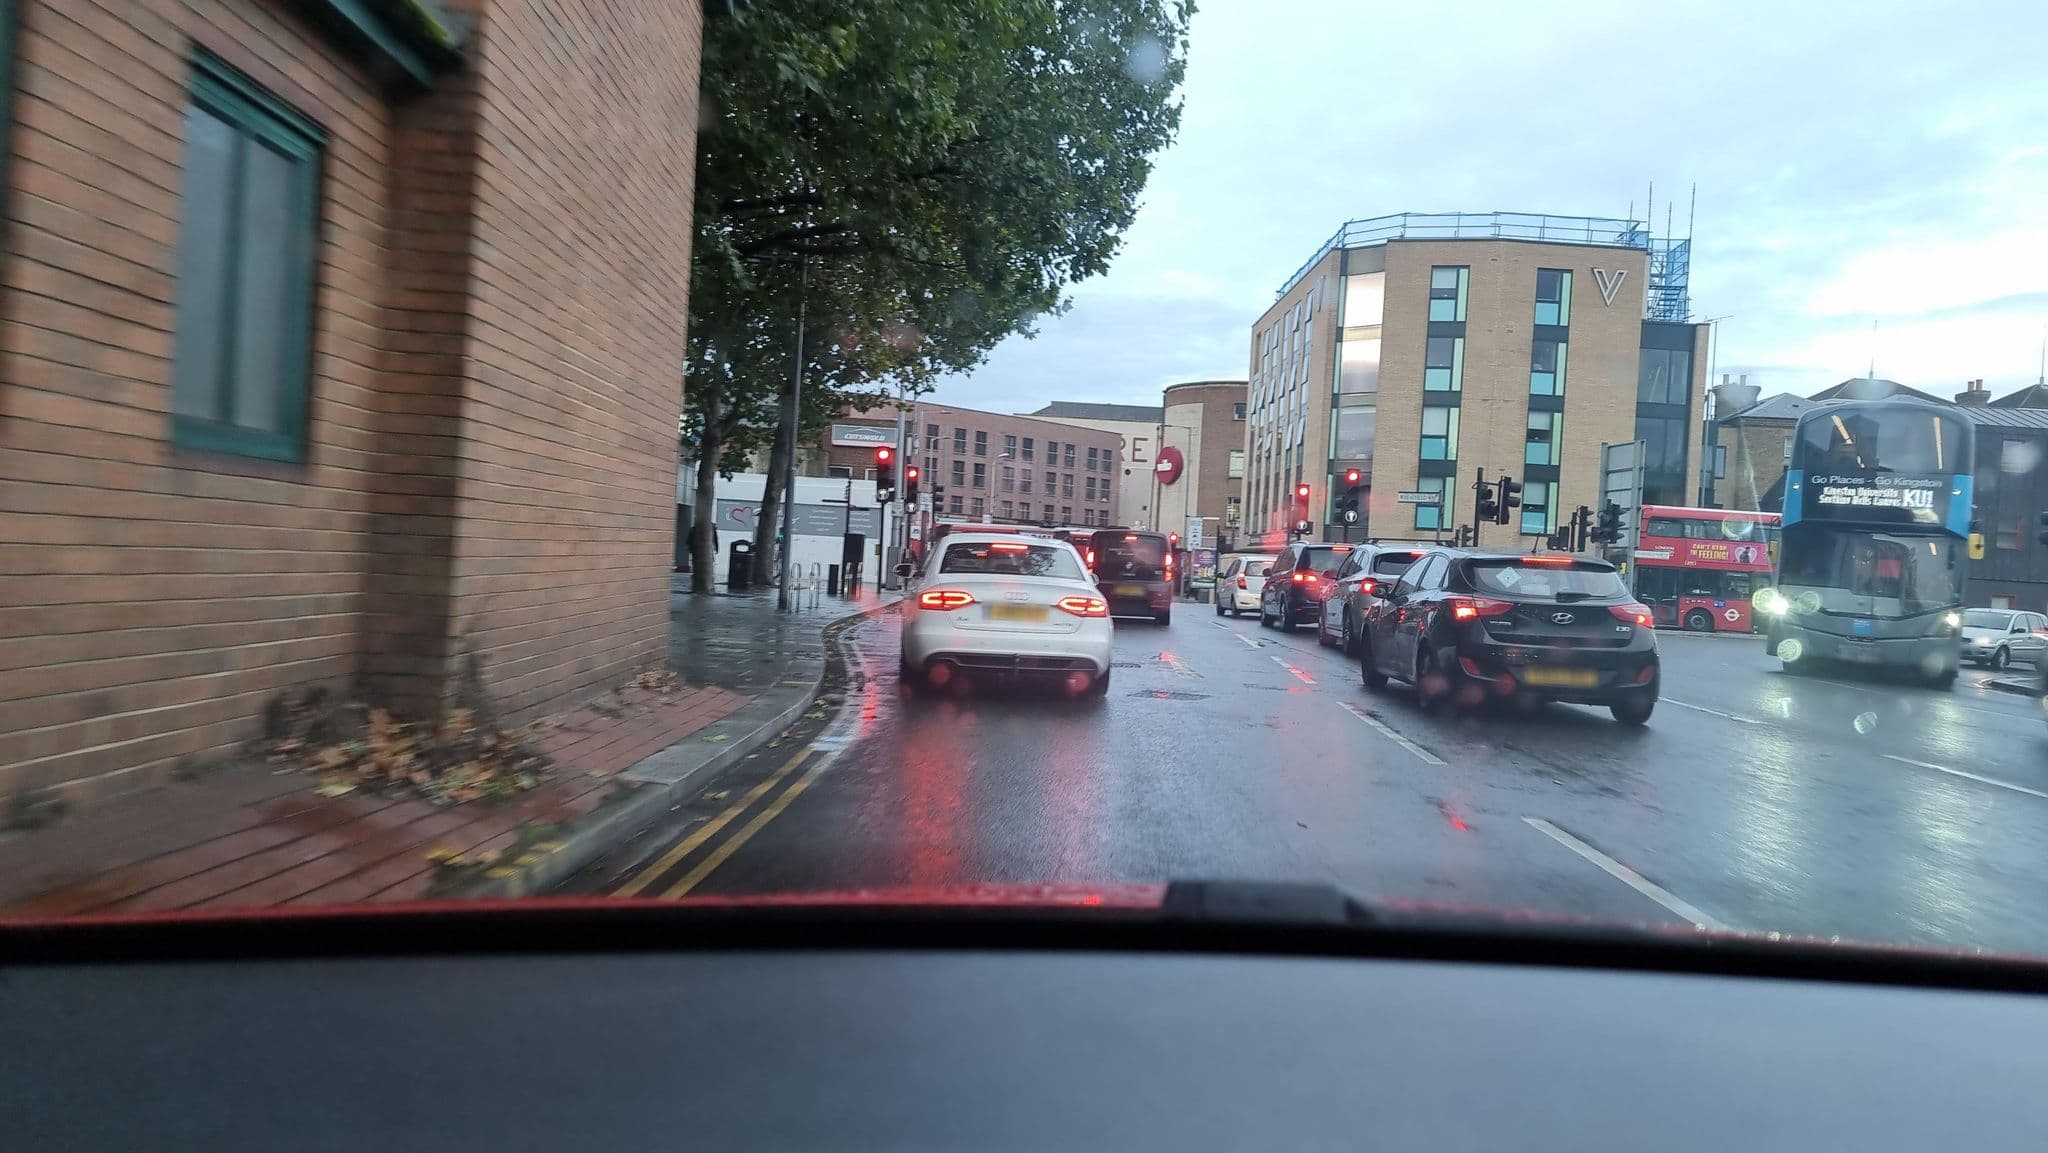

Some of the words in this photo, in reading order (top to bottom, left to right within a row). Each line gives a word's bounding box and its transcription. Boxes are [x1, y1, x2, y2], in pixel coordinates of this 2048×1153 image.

[1811, 475, 1827, 484] Go
[1829, 475, 1864, 485] Places
[1875, 476, 1892, 485] Go
[1894, 477, 1943, 488] Kingston
[1902, 489, 1935, 507] KU1
[1698, 550, 1729, 561] FEELING!
